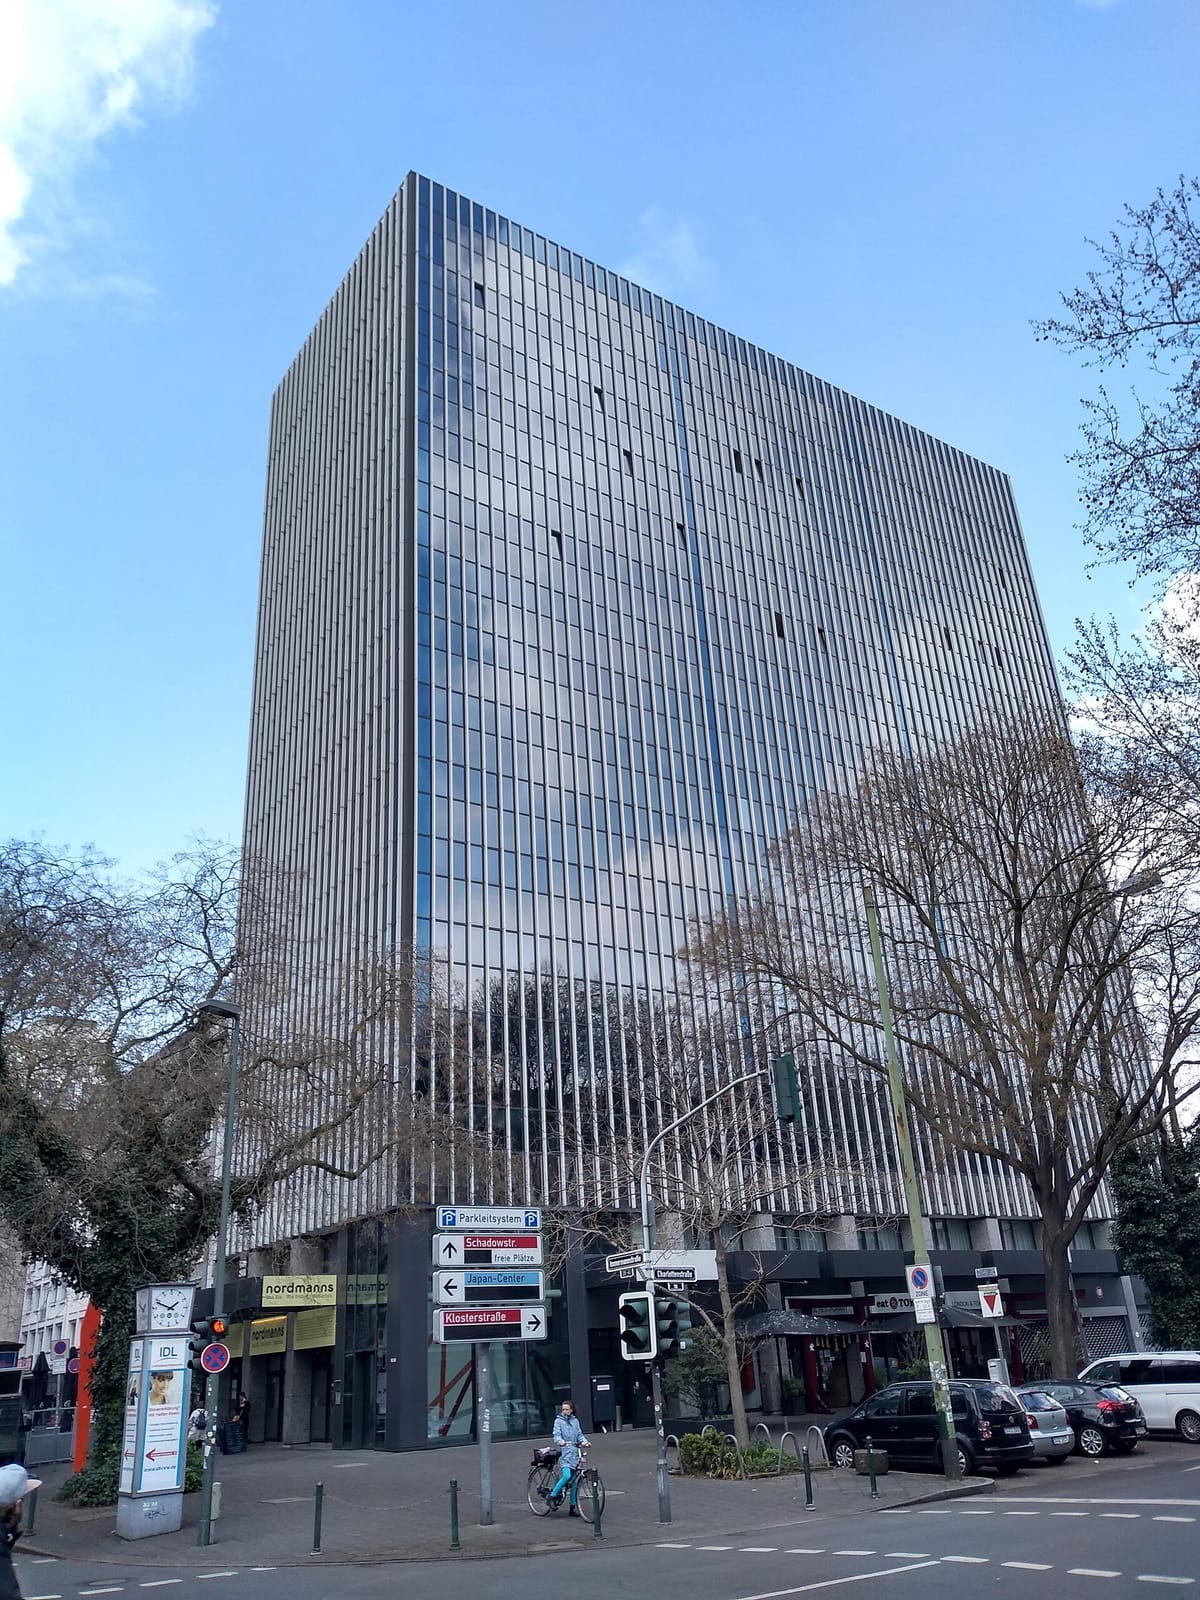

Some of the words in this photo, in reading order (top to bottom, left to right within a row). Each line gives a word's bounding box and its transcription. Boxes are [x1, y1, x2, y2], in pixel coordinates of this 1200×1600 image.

[460, 1214, 522, 1225] Parkleitsystem
[466, 1238, 517, 1247] Schadowstr.
[494, 1254, 512, 1262] freie
[513, 1254, 535, 1262] Plätze
[467, 1274, 525, 1285] Japan-Center
[266, 1283, 334, 1293] nordmanns
[876, 1299, 889, 1308] eat
[445, 1312, 507, 1323] Klosterstraße
[160, 1346, 178, 1357] IDL
